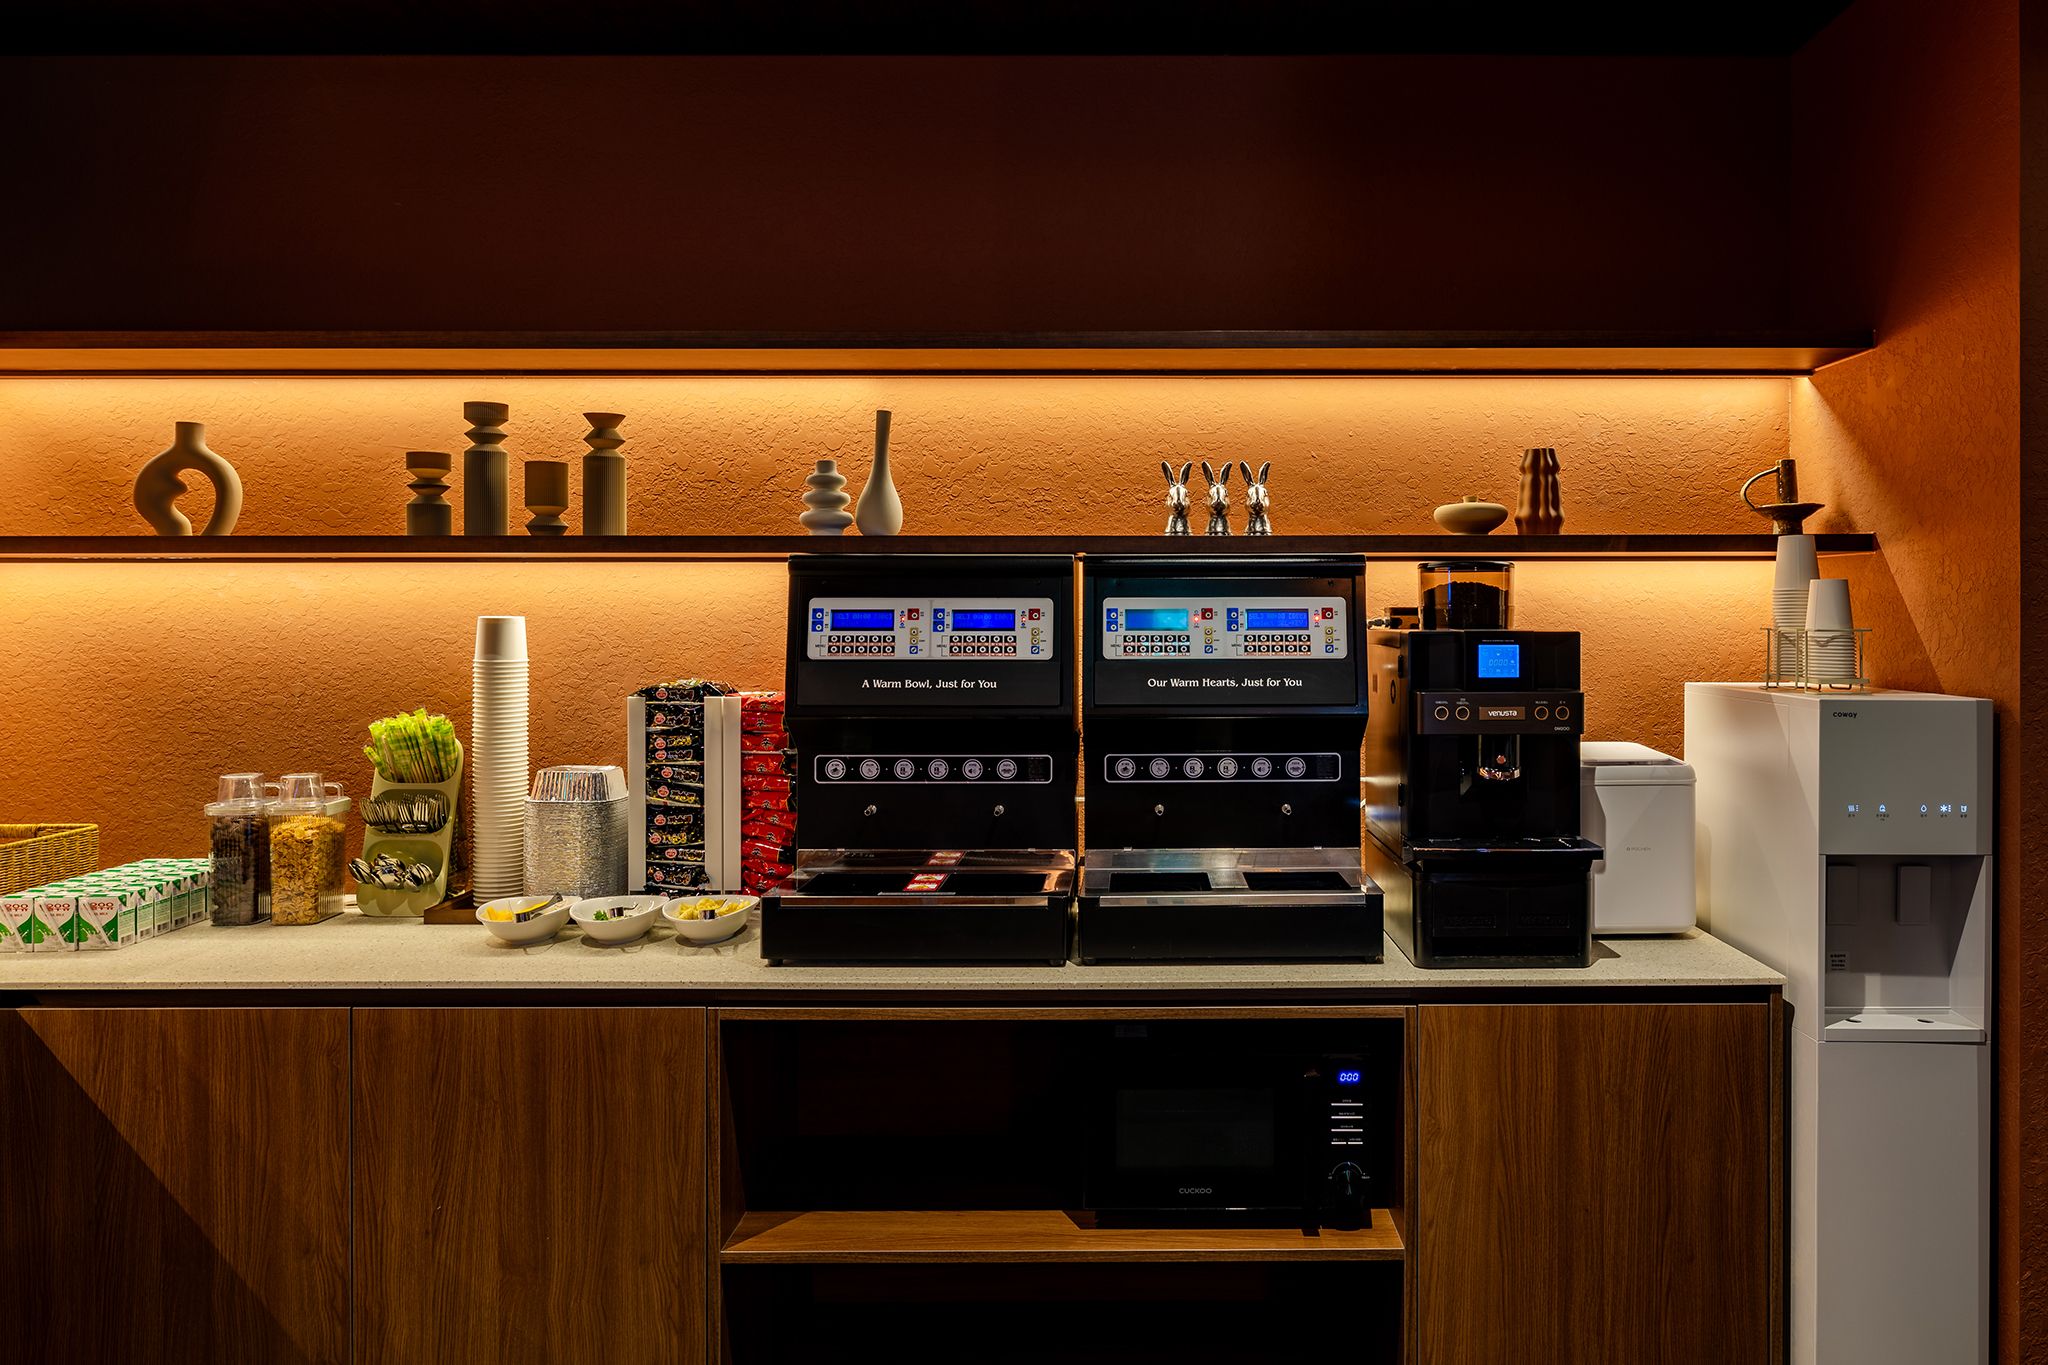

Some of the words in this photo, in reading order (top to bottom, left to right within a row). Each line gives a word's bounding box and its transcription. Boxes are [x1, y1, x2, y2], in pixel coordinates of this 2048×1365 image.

[862, 679, 870, 688] A
[873, 679, 902, 688] Warm
[905, 679, 932, 689] Bowl,
[935, 680, 958, 688] Just
[960, 679, 976, 688] for
[977, 680, 997, 688] You
[1147, 678, 1168, 687] Our
[1170, 678, 1199, 687] Warm
[1202, 678, 1239, 687] Hearts,
[1241, 678, 1263, 687] Just
[1266, 677, 1281, 687] for
[1283, 677, 1303, 687] You
[1832, 711, 1858, 719] coway
